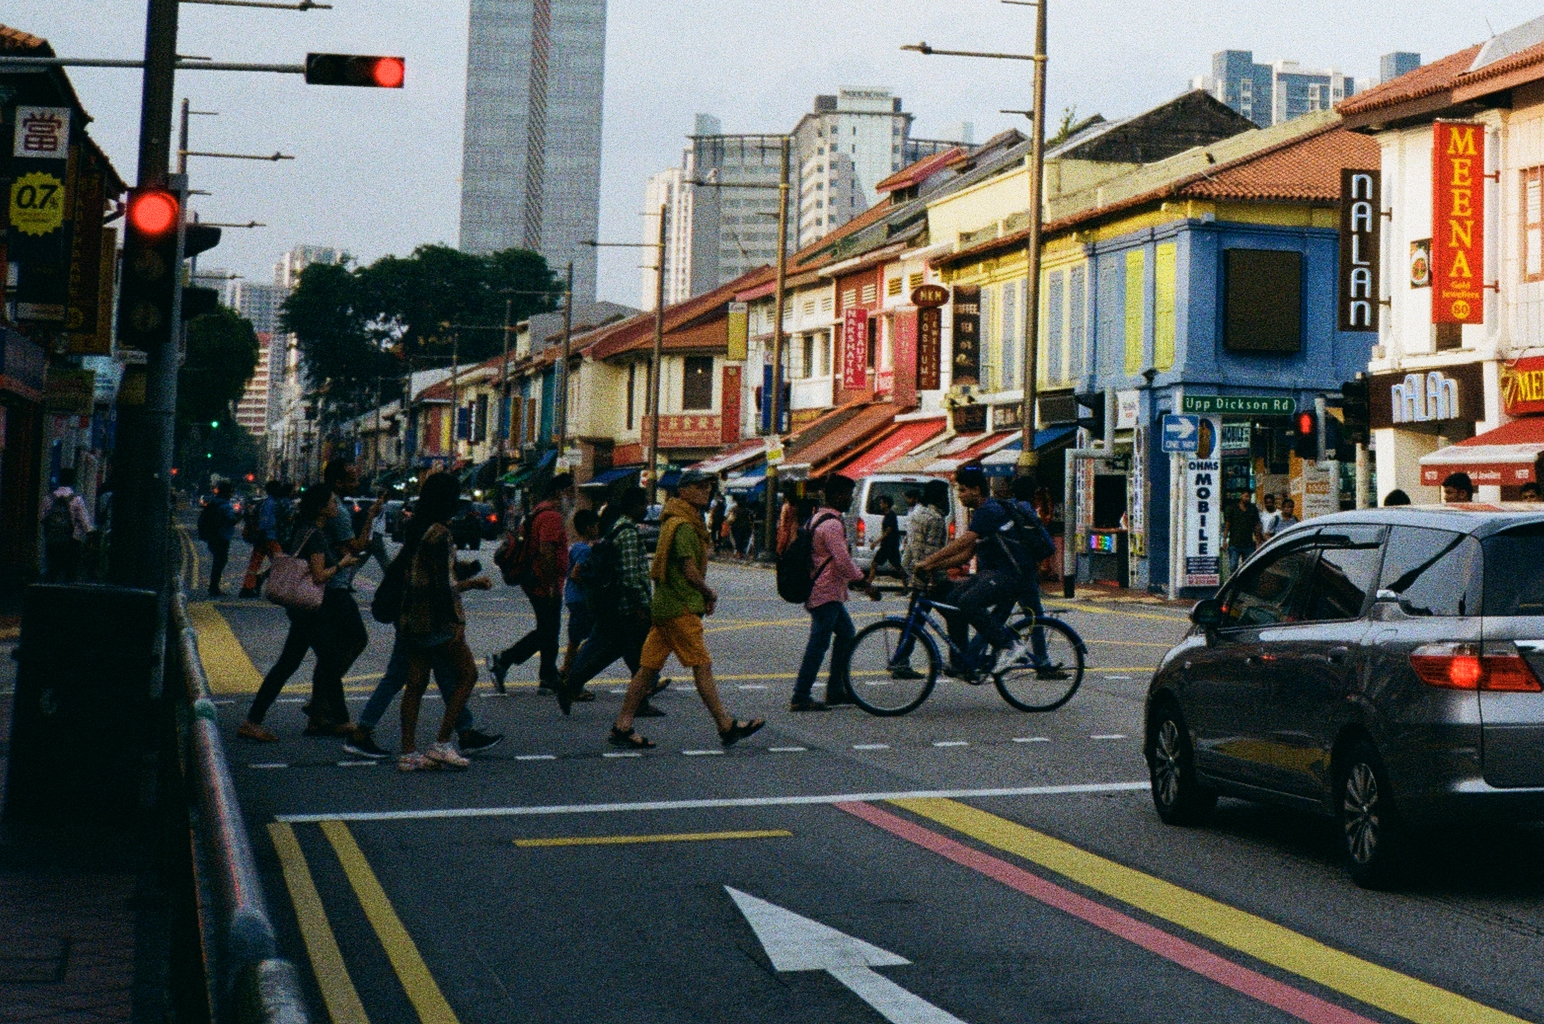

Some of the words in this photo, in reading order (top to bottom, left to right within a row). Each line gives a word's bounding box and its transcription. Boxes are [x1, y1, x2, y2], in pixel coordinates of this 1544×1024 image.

[23, 113, 62, 152] 當
[1446, 128, 1478, 278] MEENA
[846, 310, 857, 384] NAKSHATRA
[856, 322, 865, 372] BEAUTY
[1185, 397, 1211, 411] Upp
[1216, 397, 1269, 410] Dickson
[1274, 398, 1289, 410] Rd
[1165, 440, 1181, 449] ONE
[1189, 462, 1218, 471] OHMS
[1195, 473, 1213, 555] MOBILE
